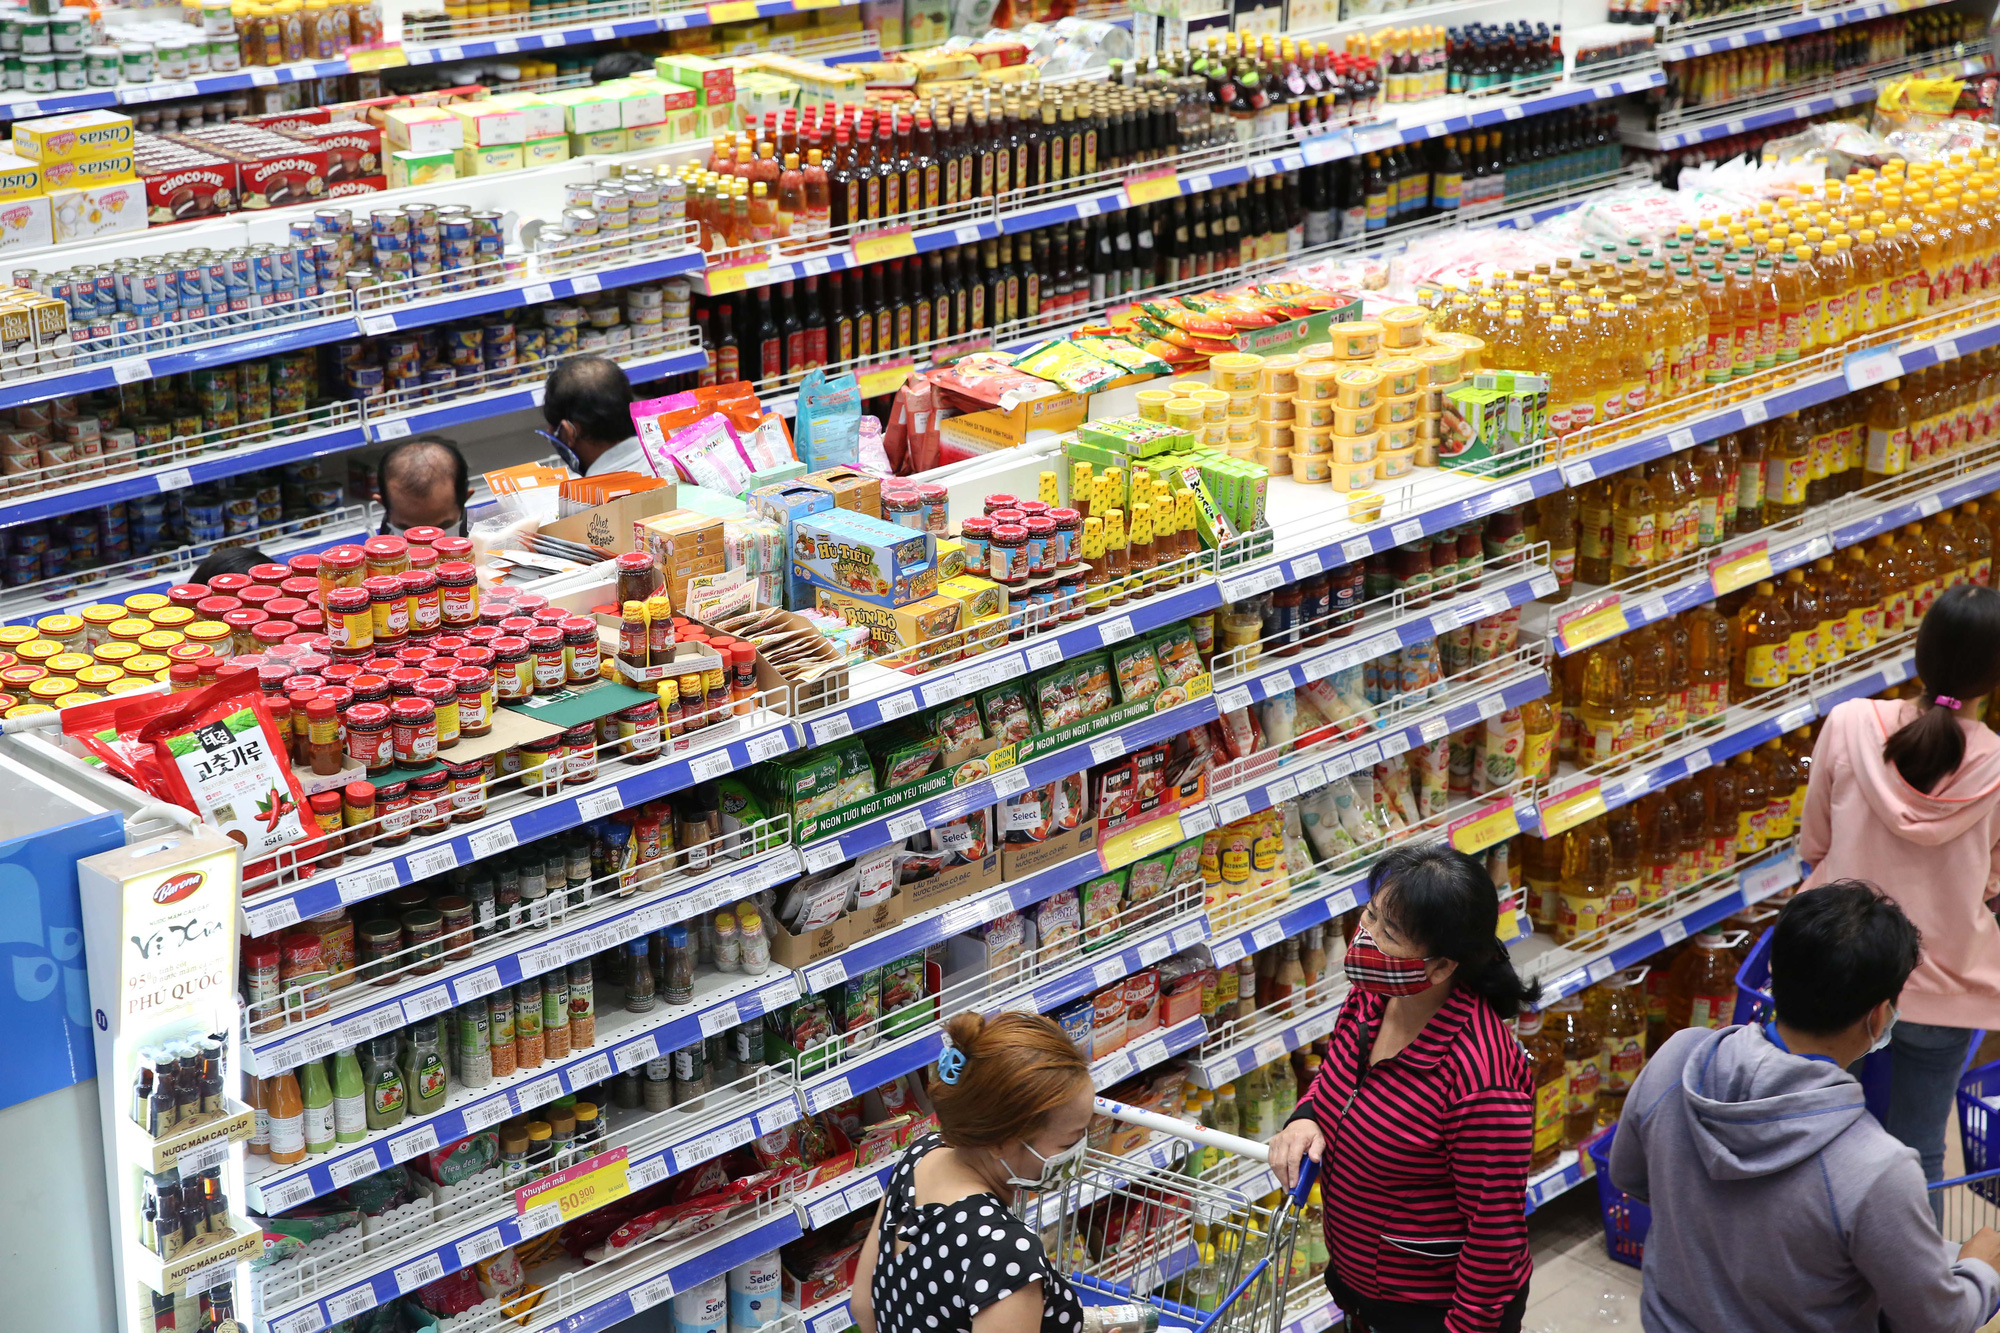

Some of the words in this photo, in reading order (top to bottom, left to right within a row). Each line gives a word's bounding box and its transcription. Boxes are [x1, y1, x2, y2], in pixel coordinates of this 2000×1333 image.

[79, 126, 130, 145] Custas
[78, 157, 131, 175] Custas
[694, 437, 725, 459] KONNYAKU
[1190, 480, 1214, 519] WASABI
[818, 543, 838, 559] HỦ
[838, 543, 871, 565] TIẾU
[831, 562, 849, 573] NAM
[849, 563, 870, 576] VANG
[876, 608, 897, 630] BÒ
[871, 626, 897, 646] HUẾ
[1037, 736, 1055, 750] NGON
[1056, 729, 1072, 743] TƯƠI
[1072, 721, 1092, 737] NGỌT,
[1092, 713, 1109, 730] TRÒN
[1110, 708, 1123, 722] YÊU
[1123, 699, 1149, 717] THƯƠNG
[193, 741, 263, 783] 고춧가루
[816, 786, 828, 794] Canh
[820, 816, 841, 831] NGON
[842, 809, 860, 823] TƯƠI
[860, 801, 882, 815] NGỌT,
[882, 792, 902, 807] TRÒN
[903, 785, 917, 799] YÊU
[917, 775, 947, 793] THƯƠNG
[1012, 811, 1038, 822] Select
[264, 836, 277, 847] 454
[277, 833, 283, 842] G
[942, 832, 968, 844] Select
[1029, 847, 1041, 857] THÁI
[153, 874, 200, 902] Barona
[926, 876, 940, 886] THÁI
[832, 943, 843, 951] PHỞ
[129, 986, 168, 1014] PHÚ
[172, 967, 223, 1000] QUỐC
[572, 984, 586, 992] Muối
[162, 1143, 187, 1158] NƯỚC
[188, 1134, 210, 1149] MẮM
[211, 1127, 229, 1140] CAO
[230, 1120, 248, 1133] CẤP
[522, 1181, 551, 1198] Khuyến
[551, 1174, 566, 1187] mãi
[560, 1192, 580, 1213] 50
[579, 1185, 595, 1199] 900
[171, 1265, 196, 1280] NƯỚC
[197, 1256, 218, 1270] MẮM
[219, 1248, 237, 1261] CAO
[238, 1240, 256, 1253] CẤP
